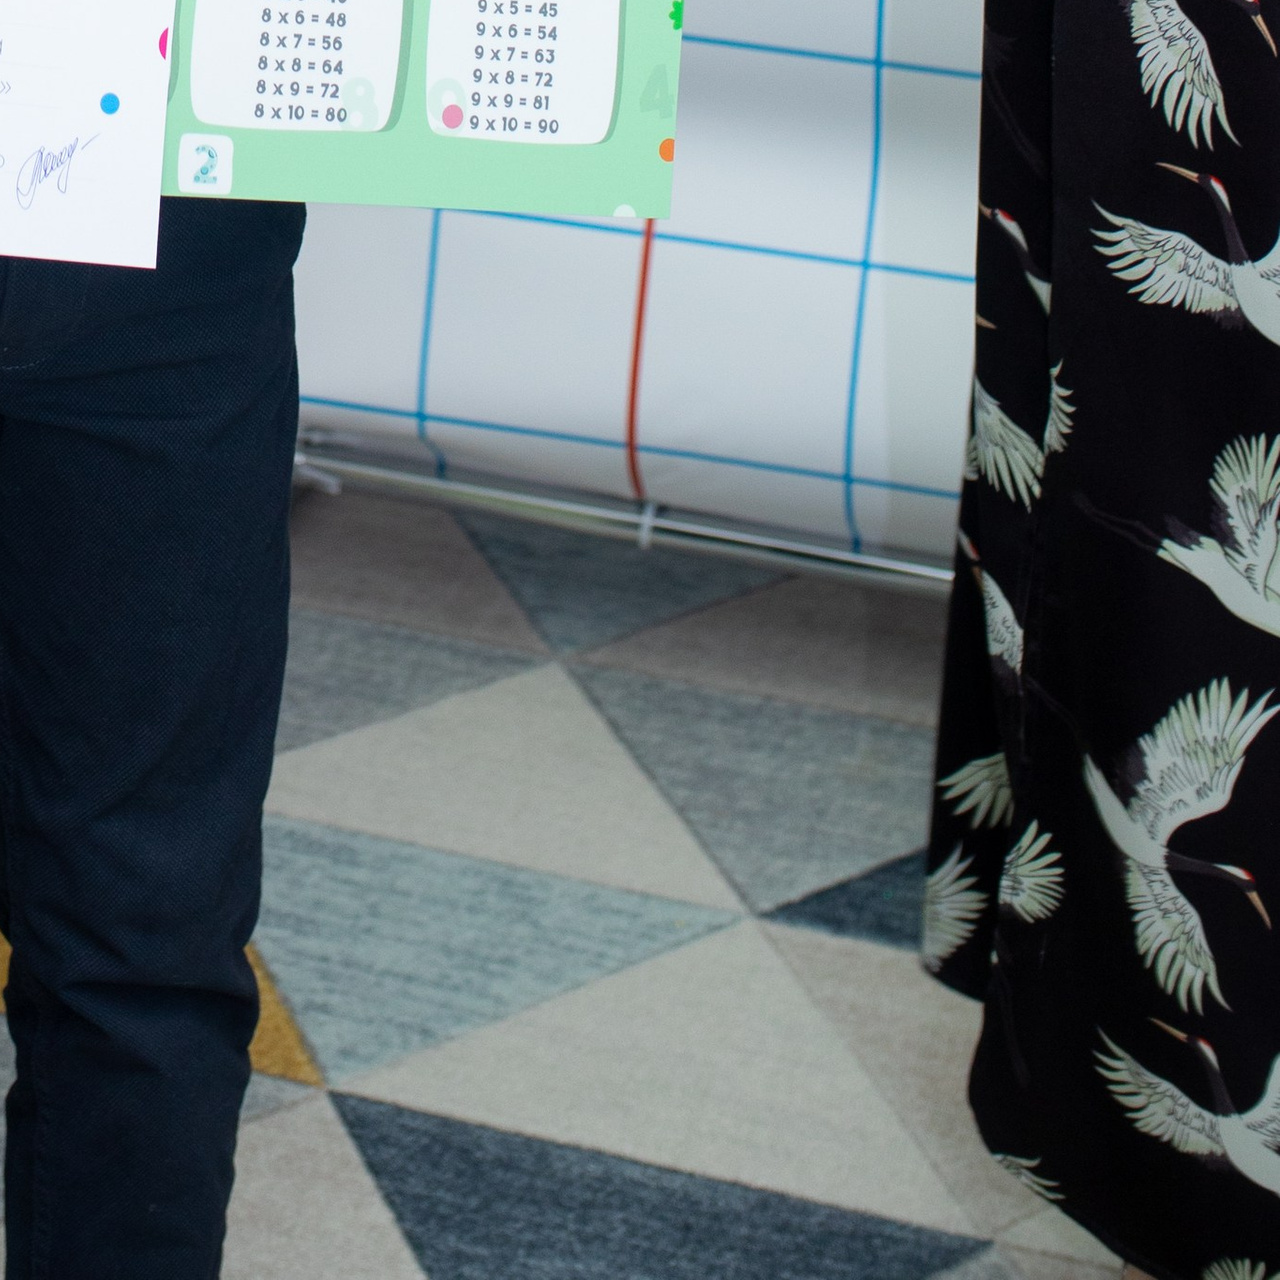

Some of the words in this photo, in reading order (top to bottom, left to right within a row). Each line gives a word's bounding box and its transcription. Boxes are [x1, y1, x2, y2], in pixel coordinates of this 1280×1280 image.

[476, 21, 485, 36] 9
[508, 23, 517, 38] 6
[537, 25, 557, 40] 54
[259, 31, 269, 46] 8
[293, 33, 302, 48] 7
[322, 35, 342, 50] 56
[472, 68, 482, 82] 9
[505, 70, 514, 84] 8
[535, 71, 552, 87] 72
[255, 79, 266, 94] 8
[289, 81, 299, 96] 9
[320, 82, 339, 98] 72
[469, 115, 479, 129] 9
[502, 116, 517, 131] 10
[538, 118, 558, 133] 90
[193, 145, 218, 184] 2
